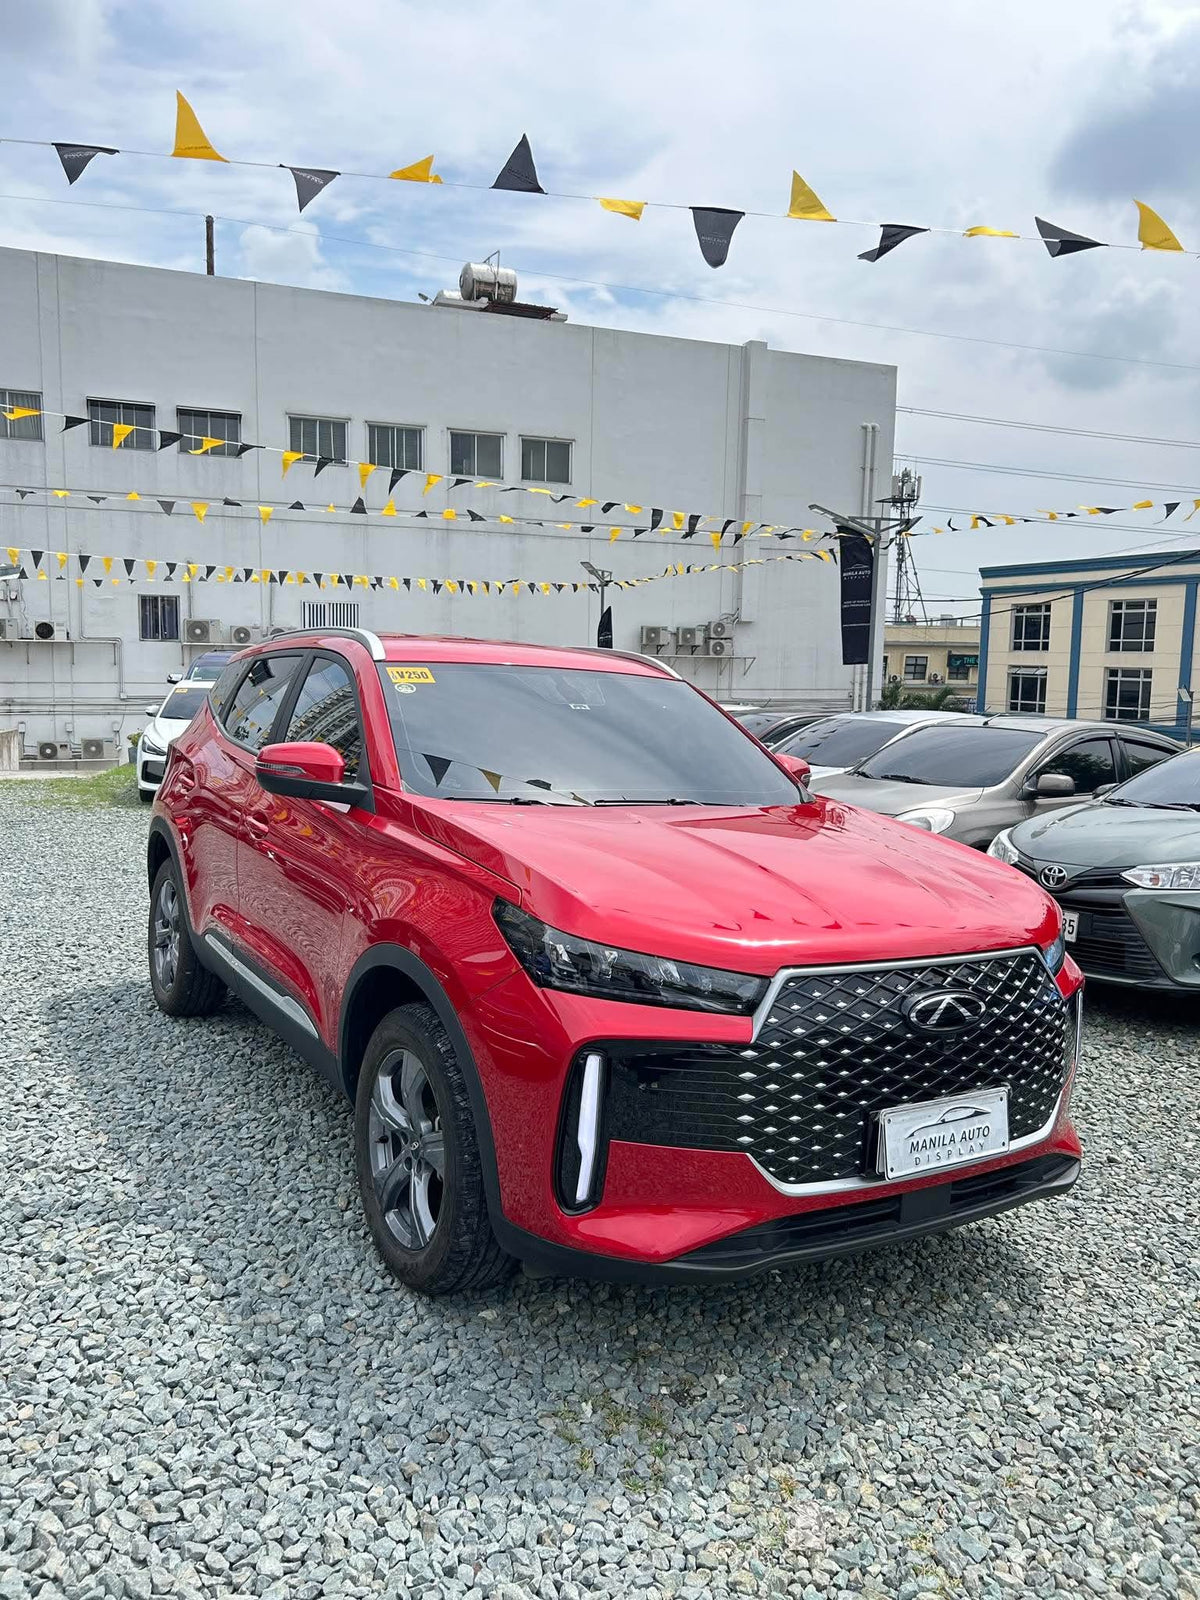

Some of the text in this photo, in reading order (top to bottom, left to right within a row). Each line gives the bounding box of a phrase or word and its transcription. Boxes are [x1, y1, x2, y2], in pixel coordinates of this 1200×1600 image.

[910, 1125, 990, 1154] MANILA AUTO
[914, 1143, 985, 1165] DISPLAY
